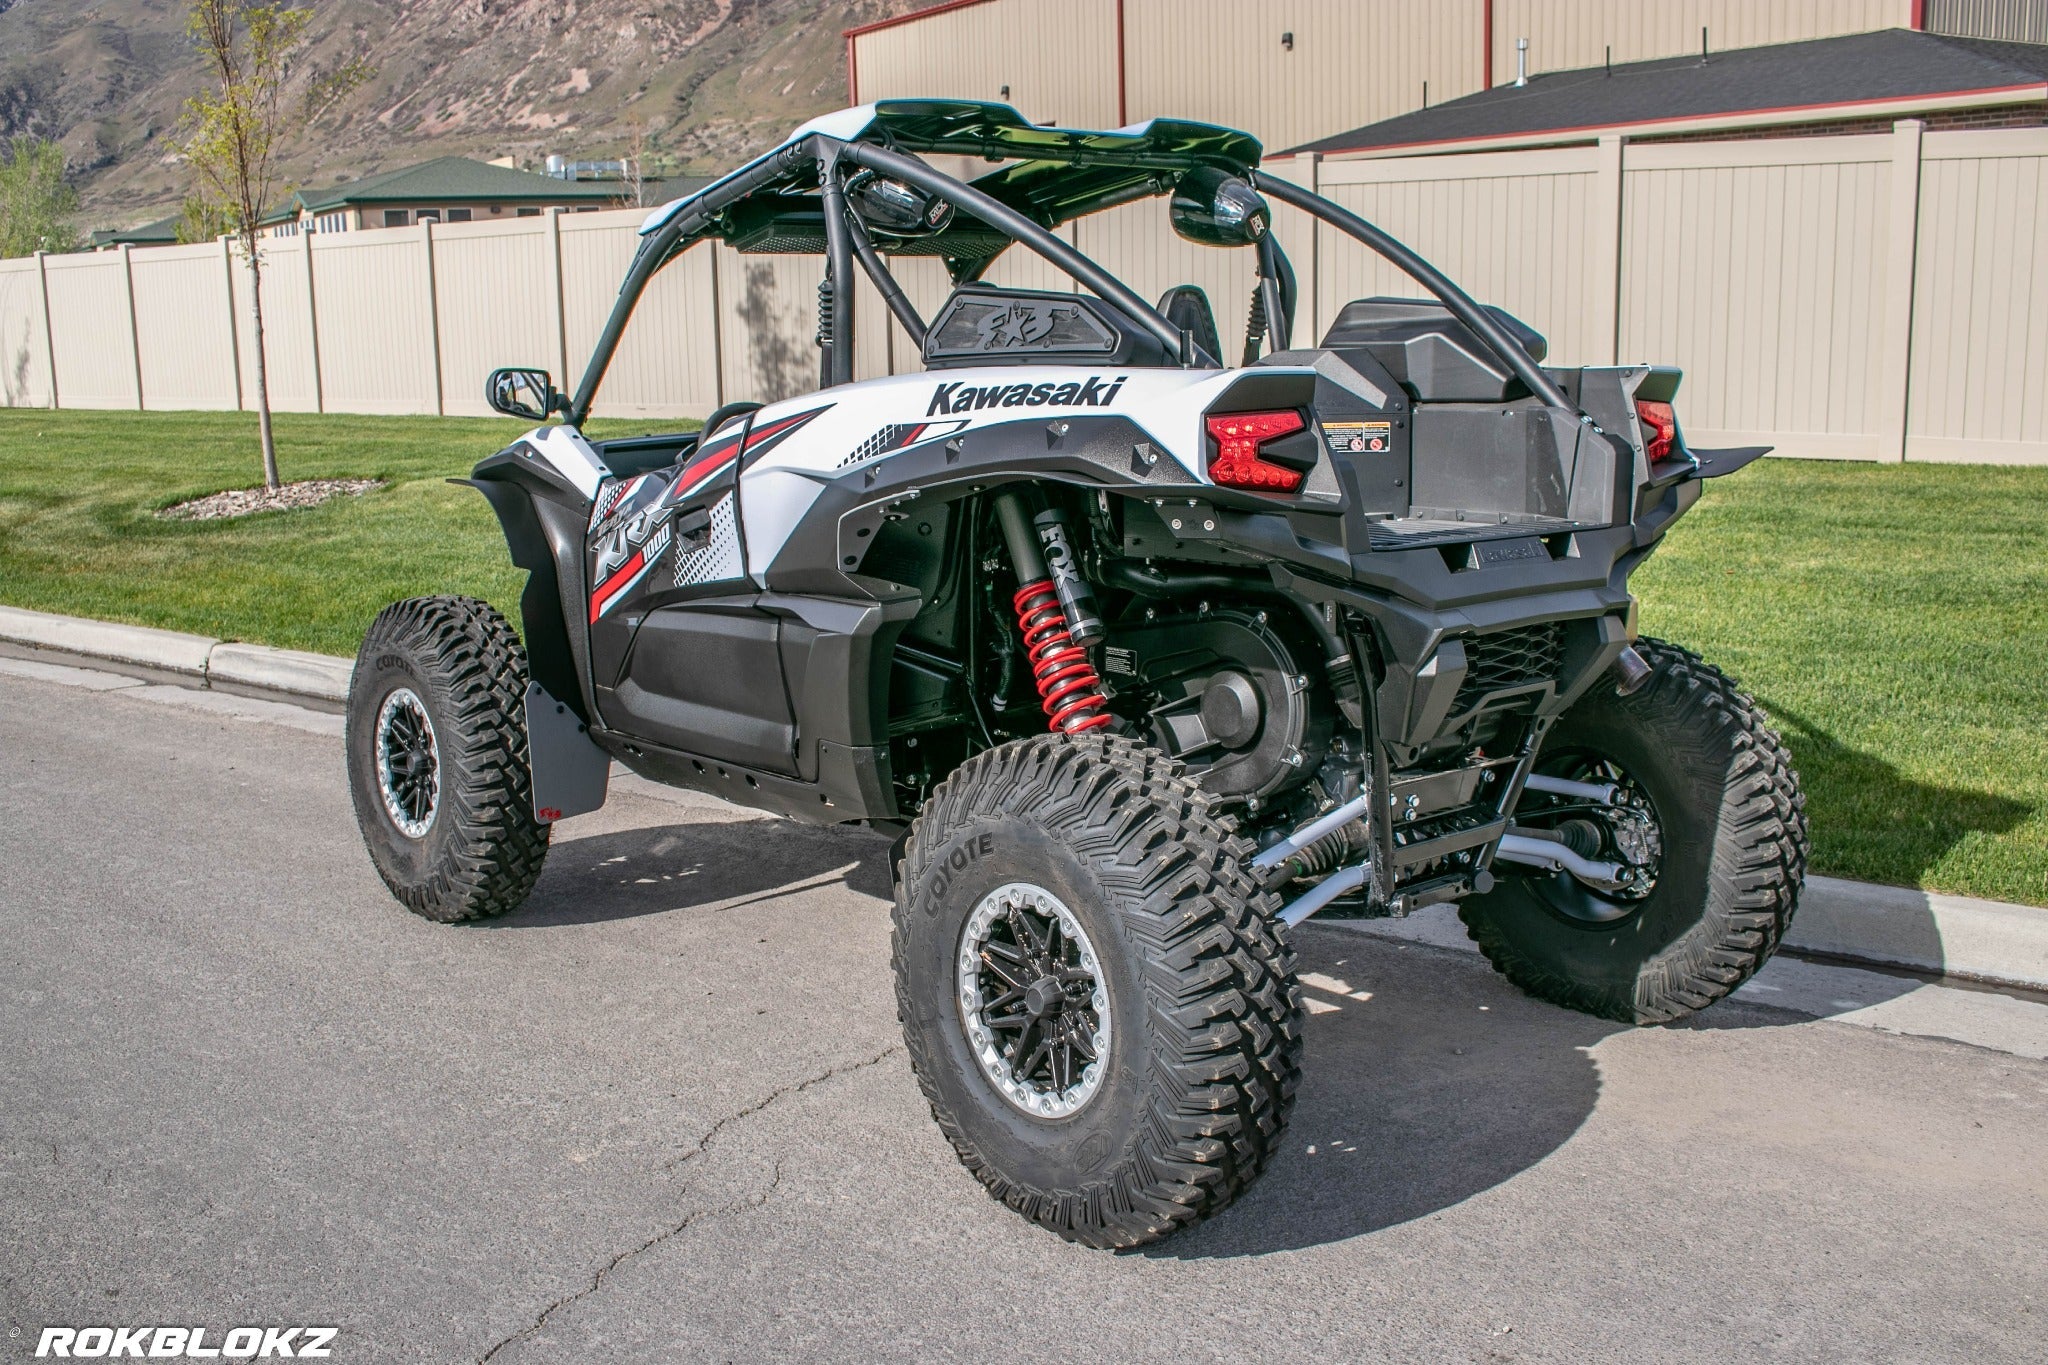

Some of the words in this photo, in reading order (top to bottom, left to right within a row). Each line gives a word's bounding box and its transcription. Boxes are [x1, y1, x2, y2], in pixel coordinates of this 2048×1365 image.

[926, 376, 1128, 417] Kawasaki
[641, 523, 671, 563] 1000
[1041, 523, 1080, 590] FOX
[376, 654, 417, 682] COYOTE
[923, 831, 995, 919] COYOTE
